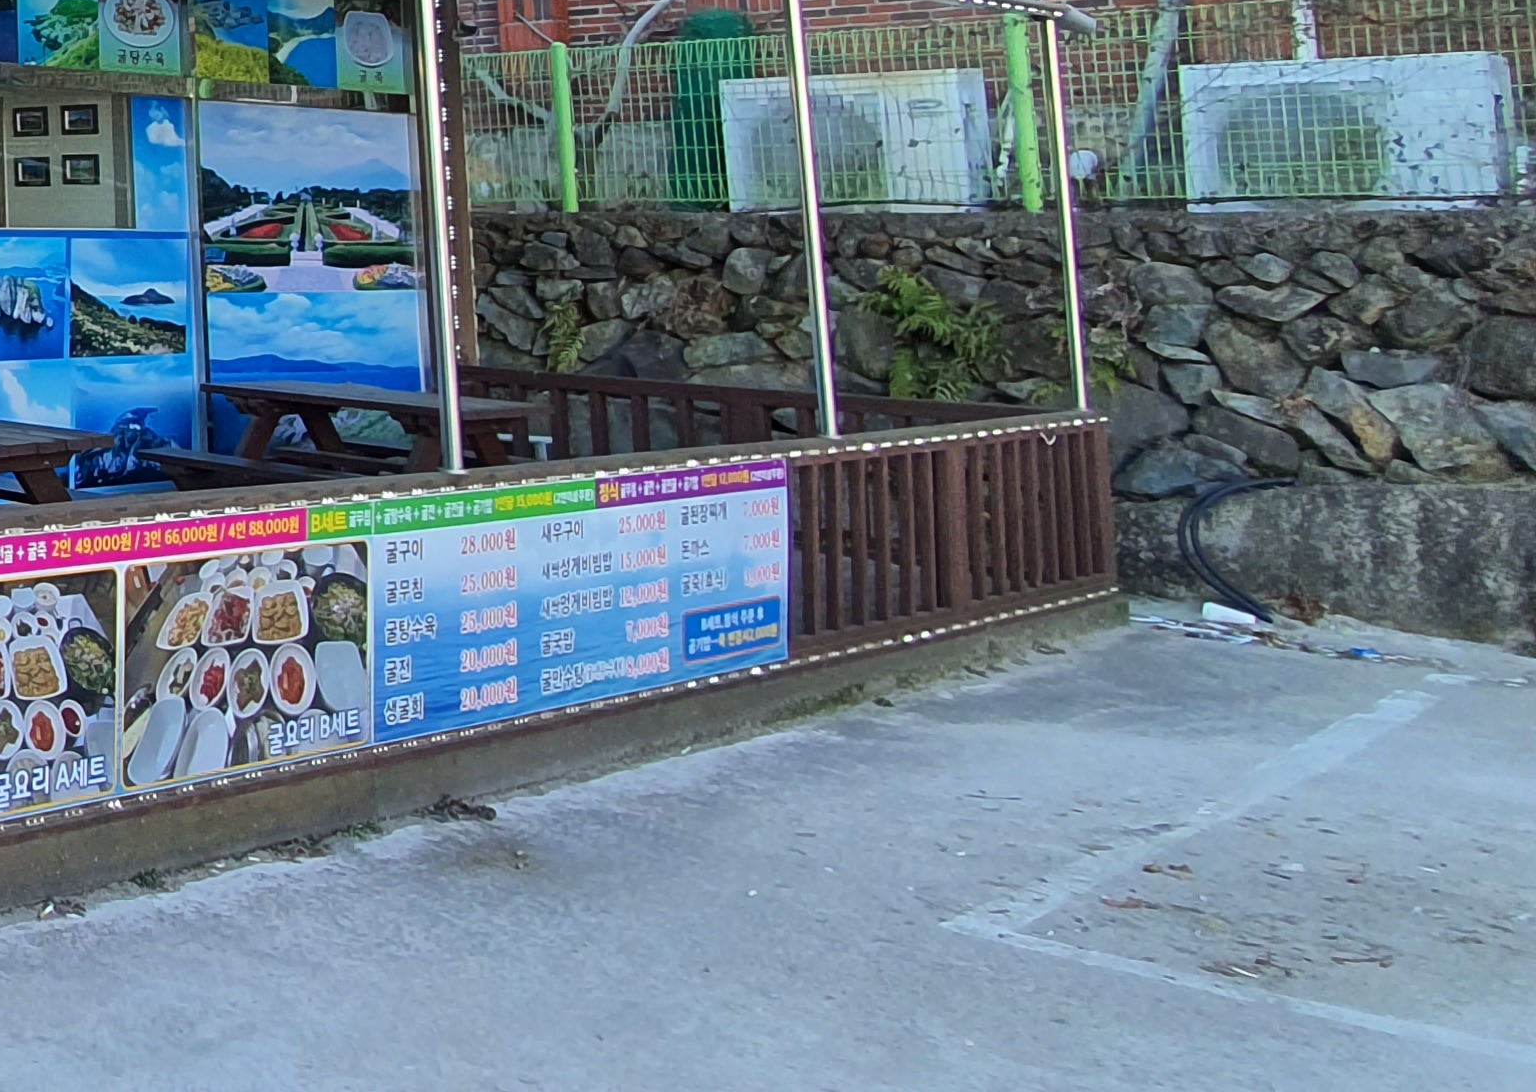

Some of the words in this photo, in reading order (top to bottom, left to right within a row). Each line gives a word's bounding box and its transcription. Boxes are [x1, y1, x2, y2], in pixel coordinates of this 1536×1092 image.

[117, 49, 165, 67] 굴탕수육
[599, 482, 619, 502] 정식
[311, 511, 347, 533] B세트
[542, 519, 583, 543] 새우구이
[619, 510, 666, 534] 25,000원
[681, 501, 727, 525] 굴된장찌개
[27, 542, 47, 561] 굴죽
[52, 538, 71, 558] 2인
[74, 532, 132, 556] 49,000원
[143, 527, 161, 548] 3인
[165, 523, 217, 545] 66,000원
[228, 520, 246, 539] 4인
[249, 515, 300, 536] 88,000원
[386, 539, 423, 564] 굴구이
[462, 529, 516, 555] 28,000원
[682, 539, 710, 560] 돈까스
[542, 552, 612, 580] 새싹성게비빔밥
[620, 544, 666, 570] 15,000원
[386, 578, 423, 604] 굴무침
[462, 566, 516, 593] 25,000원
[386, 615, 436, 643] 굴탕수육
[461, 603, 517, 633] 25,000원
[542, 630, 573, 656] 굴국밥
[386, 657, 411, 683] 굴전
[461, 641, 517, 671] 20,000원
[385, 694, 423, 723] 생굴회
[461, 679, 517, 709] 20,000원
[268, 720, 315, 754] 굴요리
[320, 710, 361, 738] B세트
[55, 756, 107, 791] A세트
